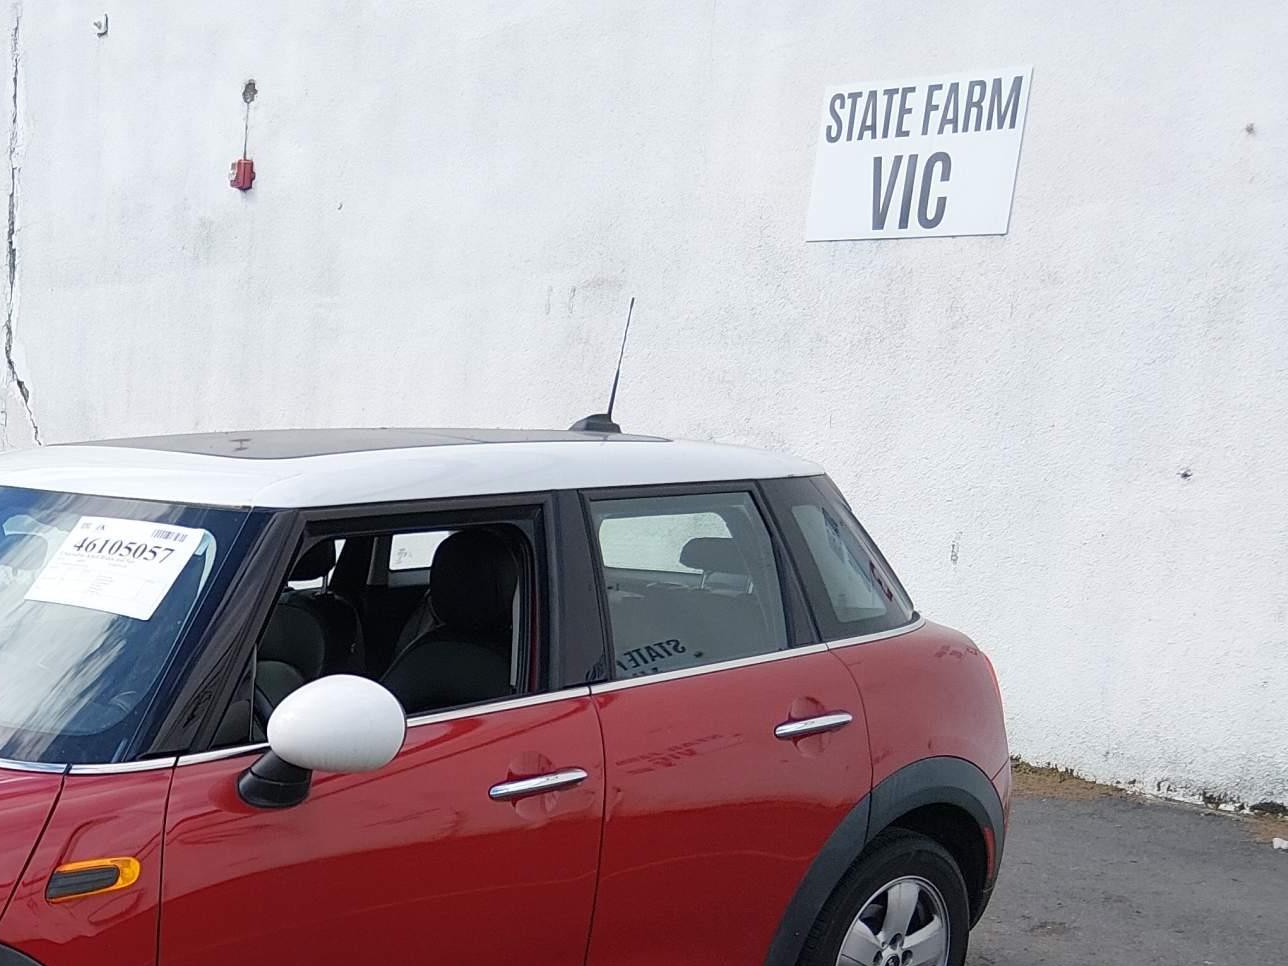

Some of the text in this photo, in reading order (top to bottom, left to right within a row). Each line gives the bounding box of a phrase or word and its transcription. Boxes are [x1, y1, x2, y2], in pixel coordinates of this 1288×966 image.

[825, 75, 1024, 143] STATE FARM
[871, 151, 952, 231] VIC
[73, 536, 176, 564] 46105057
